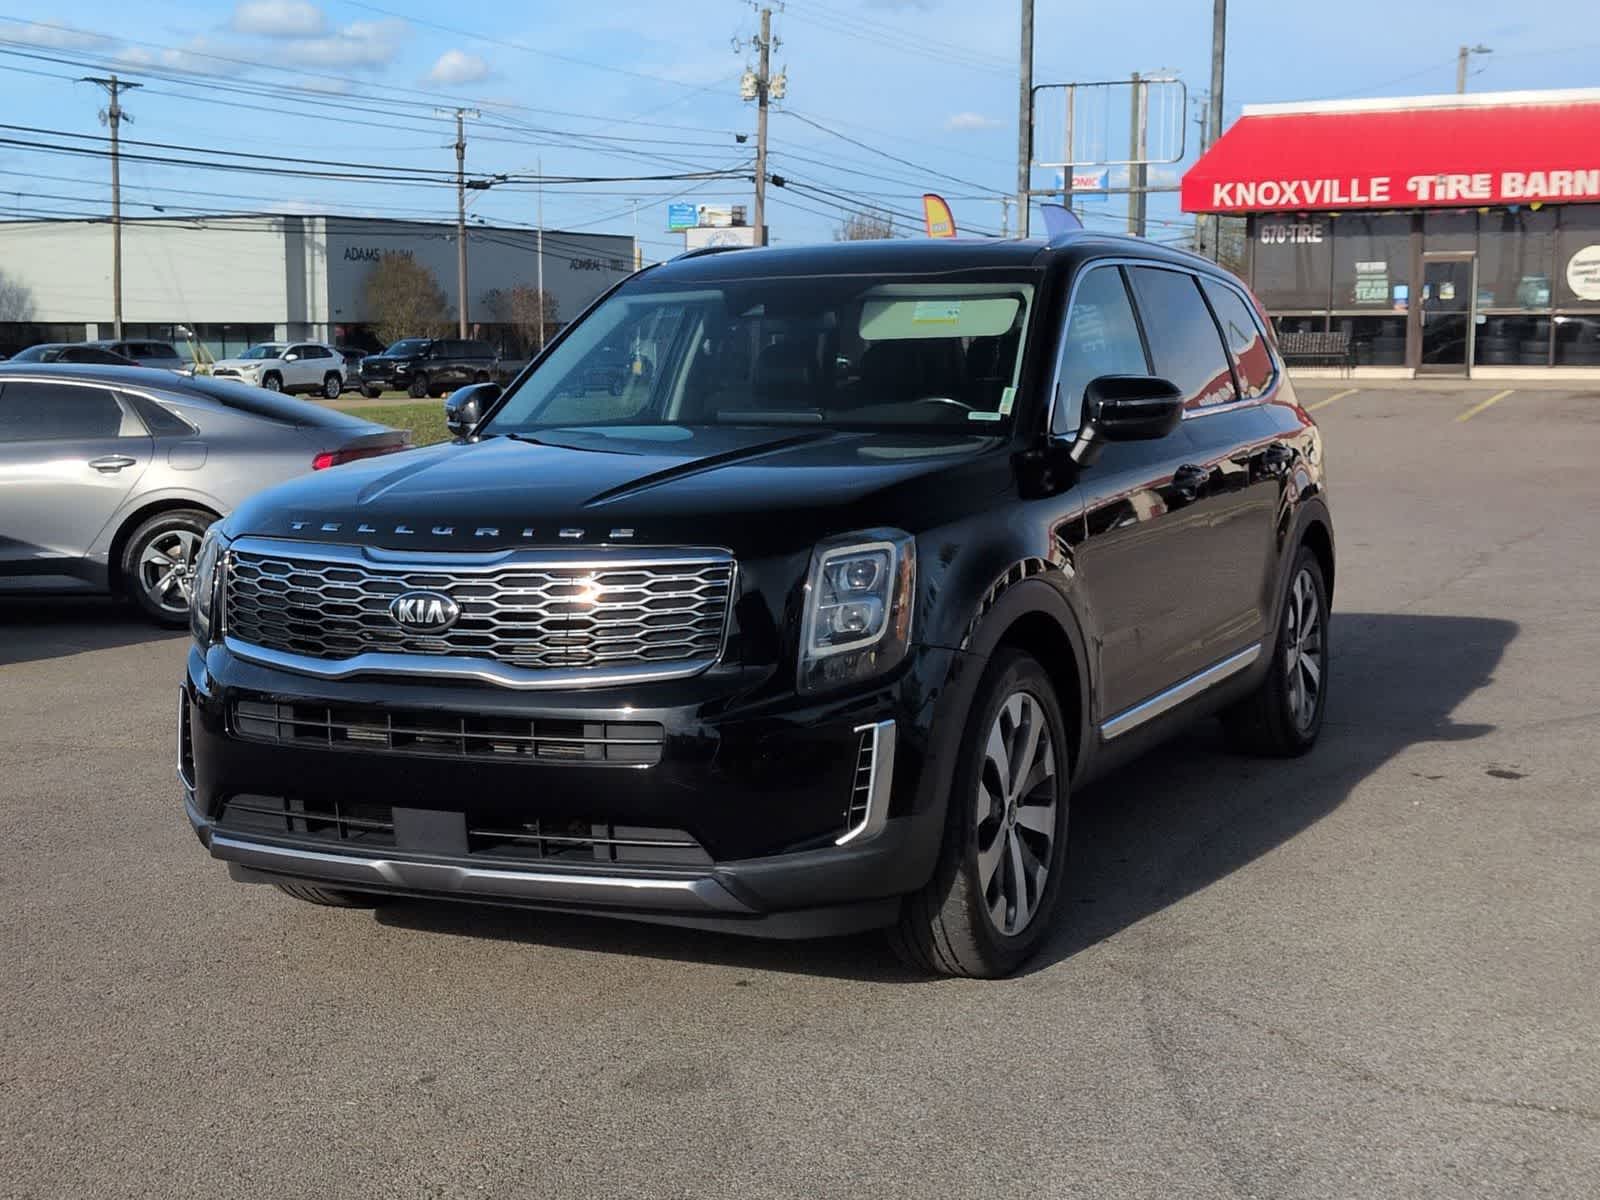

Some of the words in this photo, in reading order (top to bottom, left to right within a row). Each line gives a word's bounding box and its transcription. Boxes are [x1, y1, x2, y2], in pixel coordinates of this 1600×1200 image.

[1071, 176, 1097, 187] ONIC
[1213, 177, 1391, 207] KNOXVILLE
[1501, 170, 1600, 198] BARN
[1260, 224, 1323, 244] 670-TIRE
[343, 247, 380, 262] ADAMS
[291, 520, 635, 538] TELLURIDE
[398, 599, 446, 623] KIA
